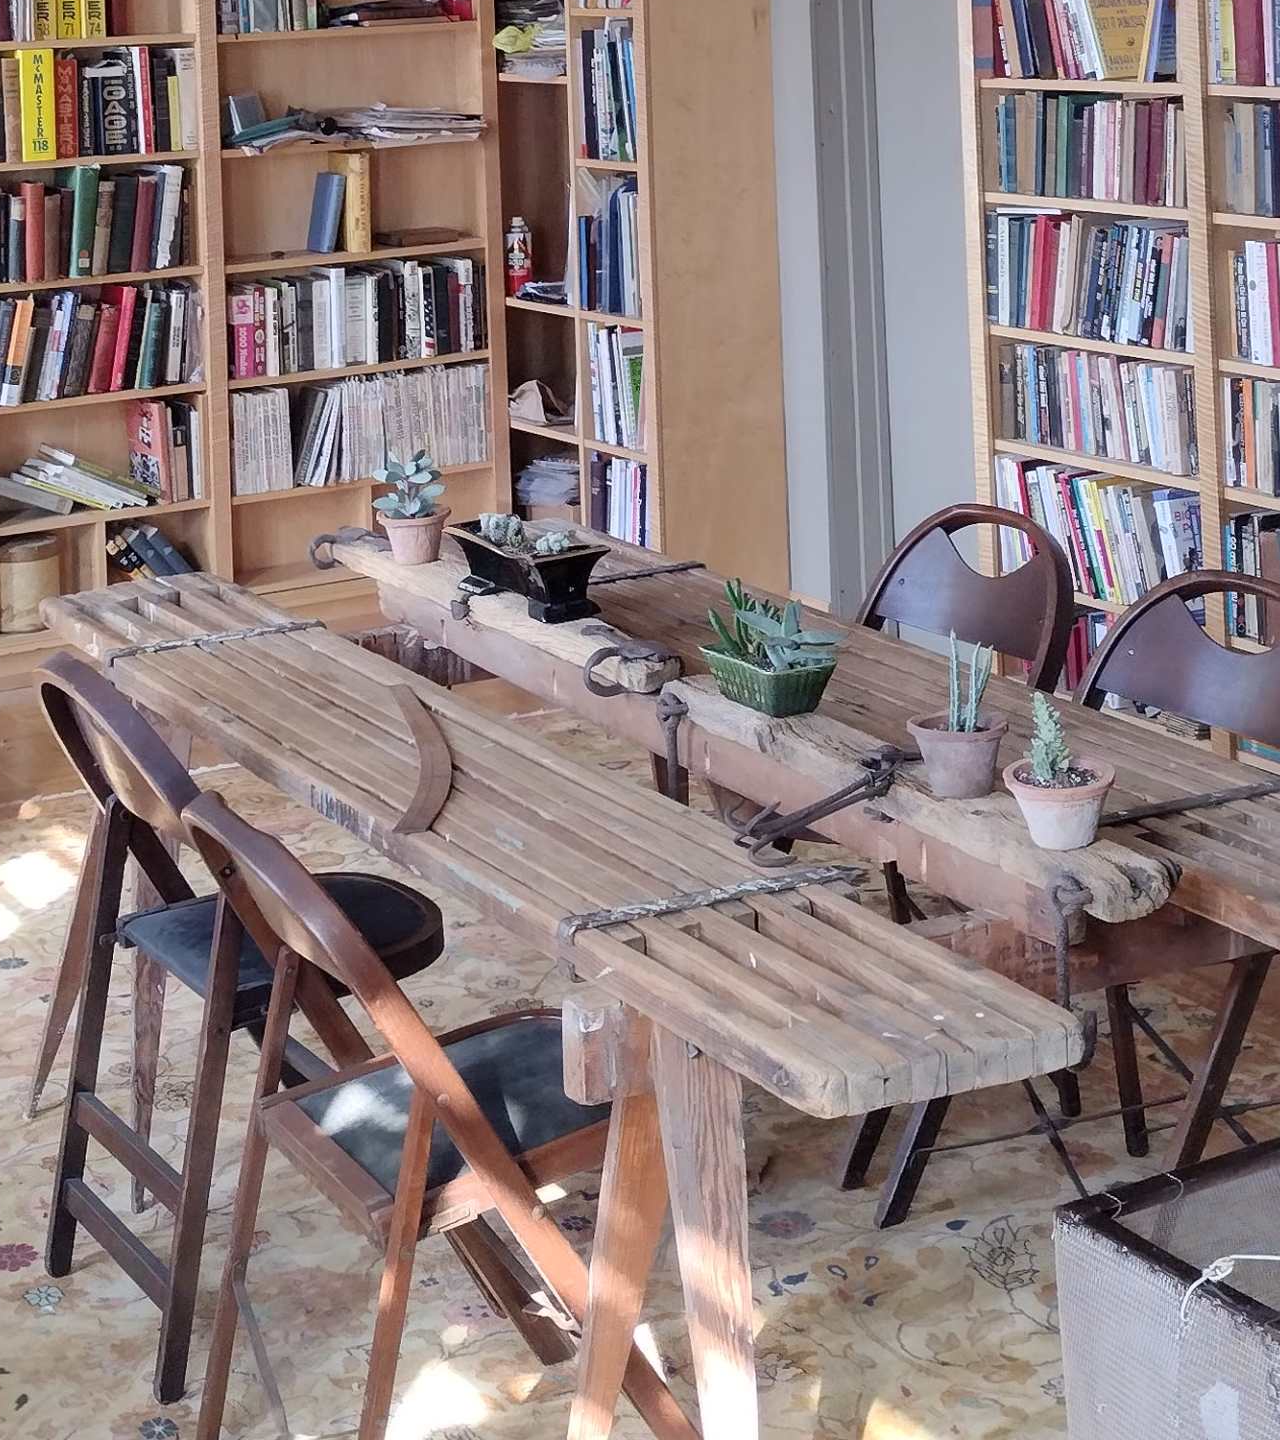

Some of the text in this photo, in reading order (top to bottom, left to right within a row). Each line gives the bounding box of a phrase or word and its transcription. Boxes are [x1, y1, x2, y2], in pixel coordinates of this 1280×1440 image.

[63, 23, 75, 35] 71
[88, 24, 101, 35] 74
[32, 53, 44, 137] McMASTER
[32, 139, 49, 151] 118
[237, 326, 247, 347] 1000
